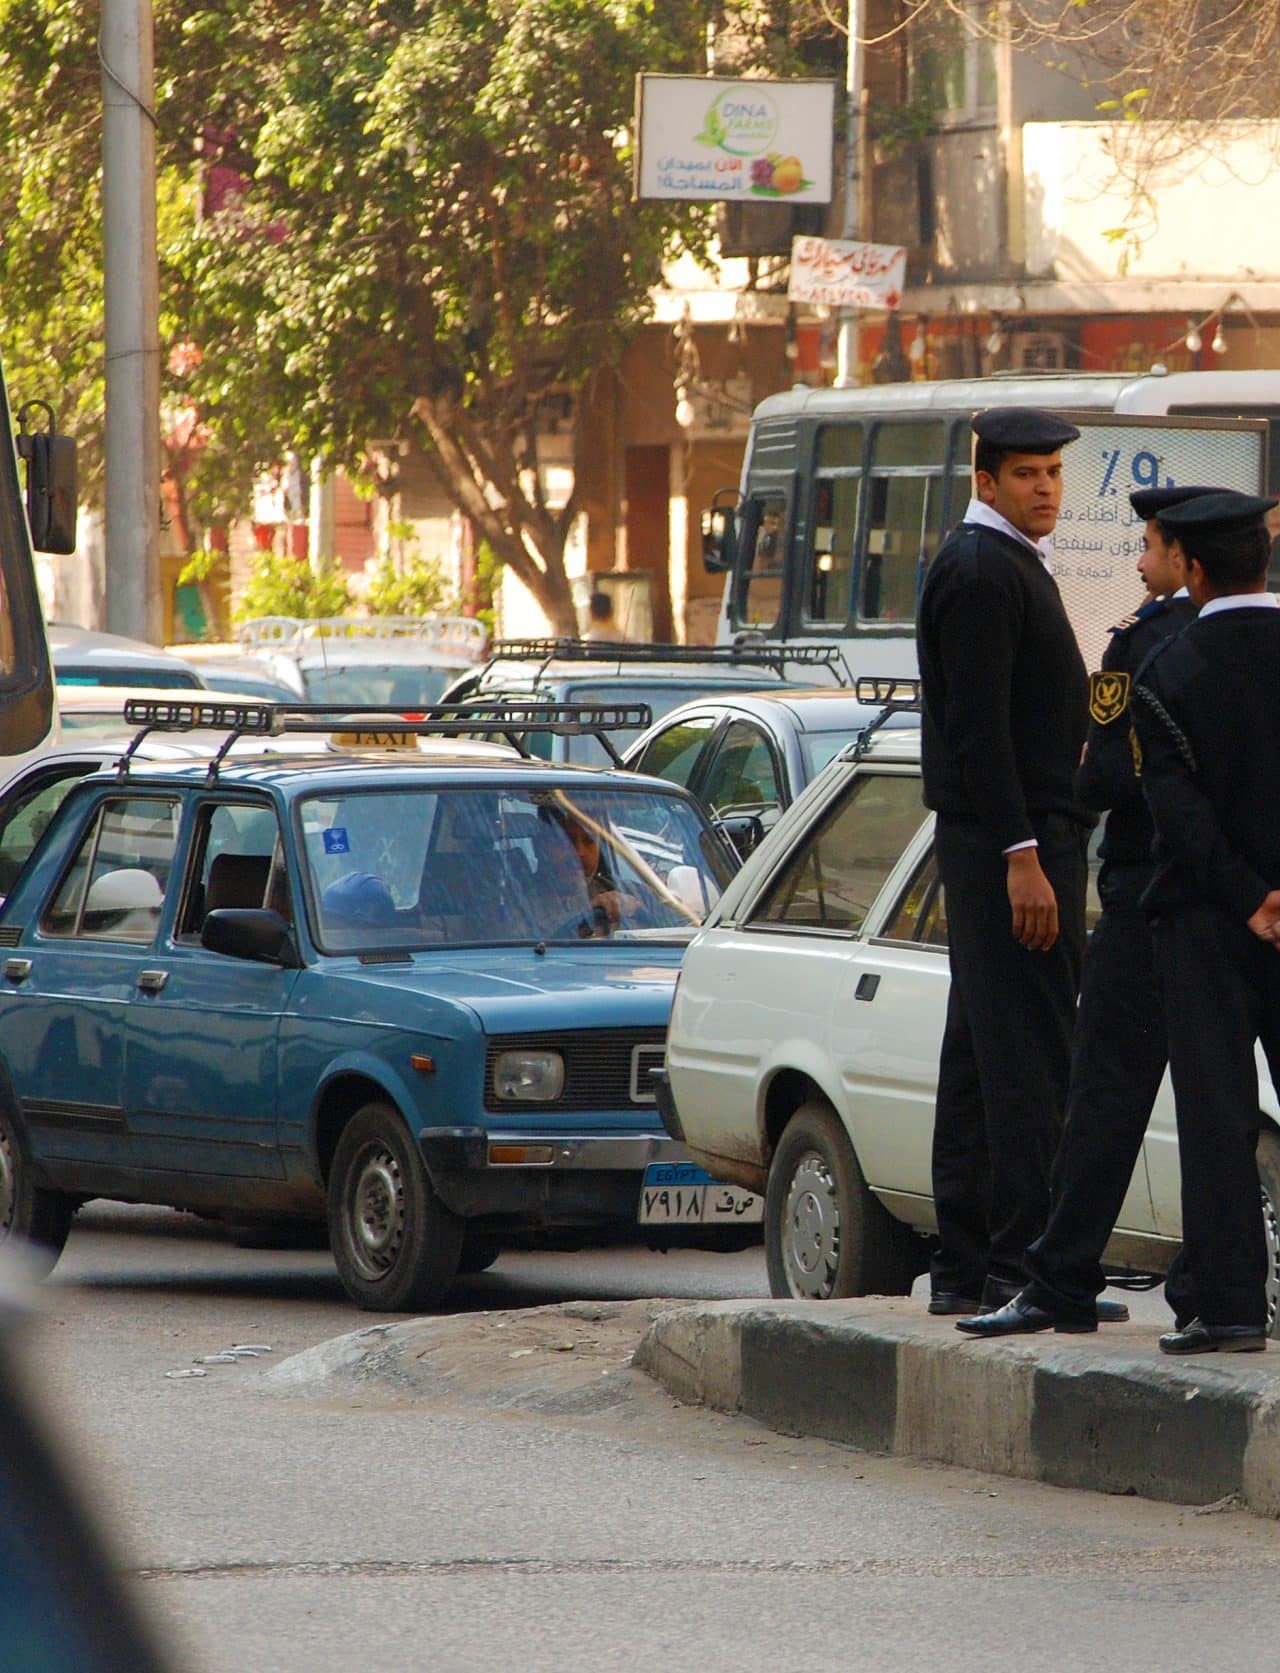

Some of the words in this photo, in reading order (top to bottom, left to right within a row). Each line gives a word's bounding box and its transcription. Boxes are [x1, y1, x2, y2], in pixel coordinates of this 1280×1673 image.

[721, 104, 769, 118] DINA
[354, 731, 407, 745] TAXI
[656, 1168, 698, 1182] EGYPT
[644, 1190, 700, 1217] ٧٩١٨
